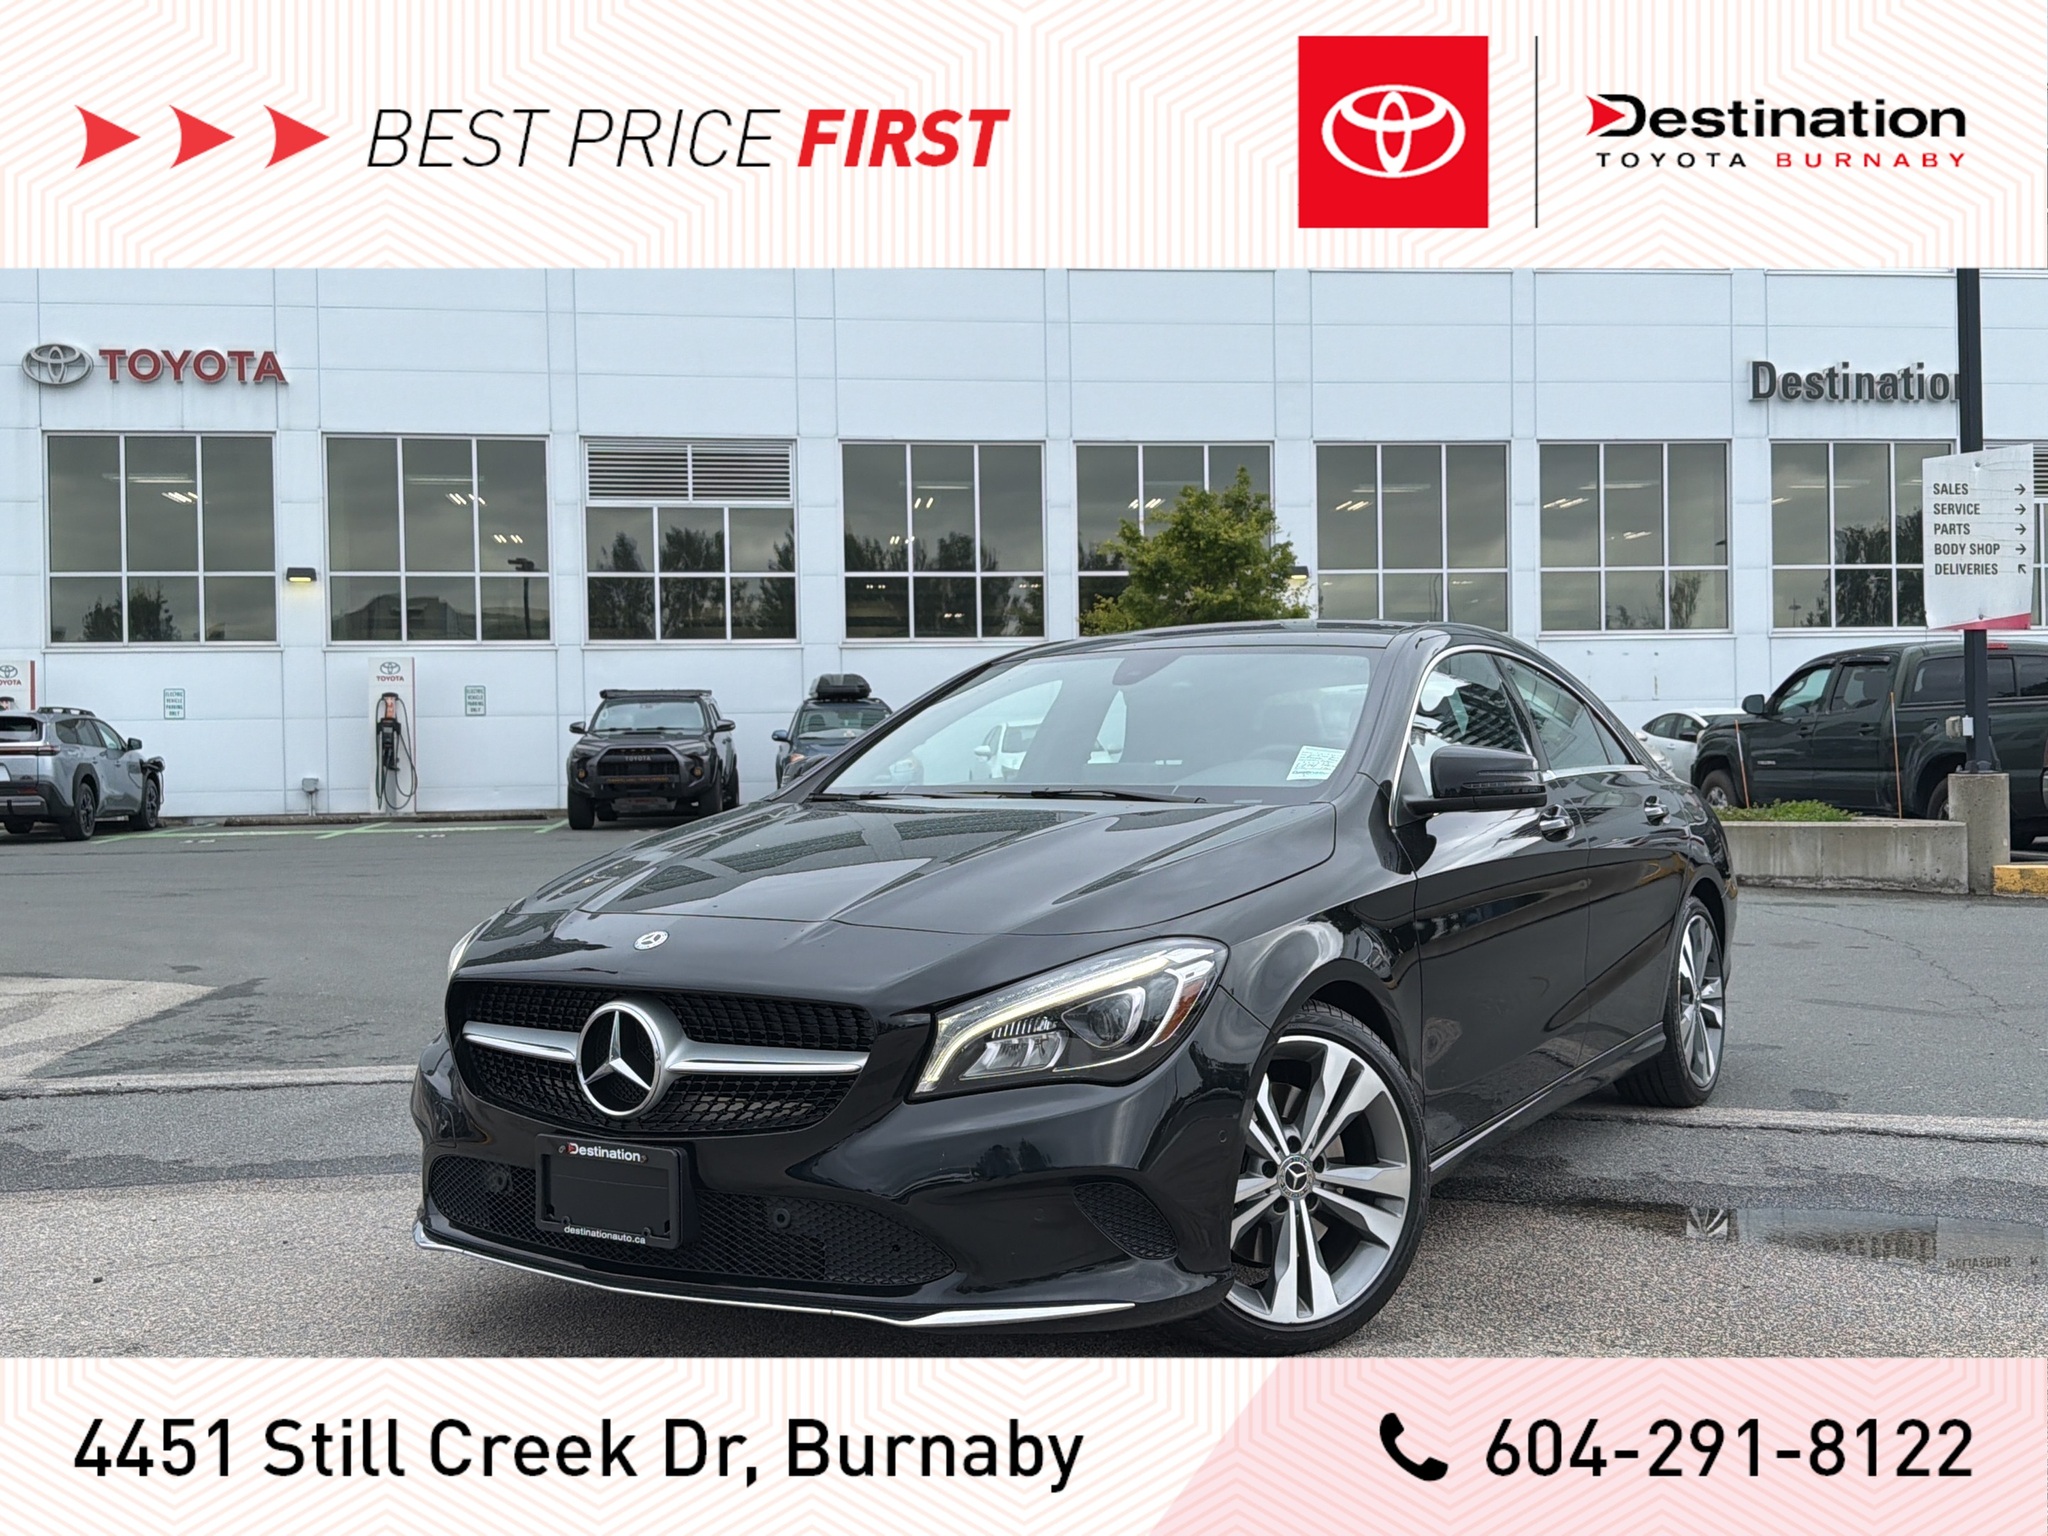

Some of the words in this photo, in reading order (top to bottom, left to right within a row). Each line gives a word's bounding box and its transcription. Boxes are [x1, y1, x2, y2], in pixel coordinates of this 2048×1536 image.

[99, 349, 287, 382] TOYOTA
[1933, 483, 1969, 495] SALES
[1933, 503, 1981, 515] SERVICE
[1934, 523, 1971, 535] PARTS
[1934, 543, 1967, 555] BODY
[1969, 543, 2000, 555] SHOP
[1934, 563, 1998, 575] DELIVERIES
[567, 1142, 641, 1162] Destination
[563, 1225, 646, 1245] destinationauto.ca
